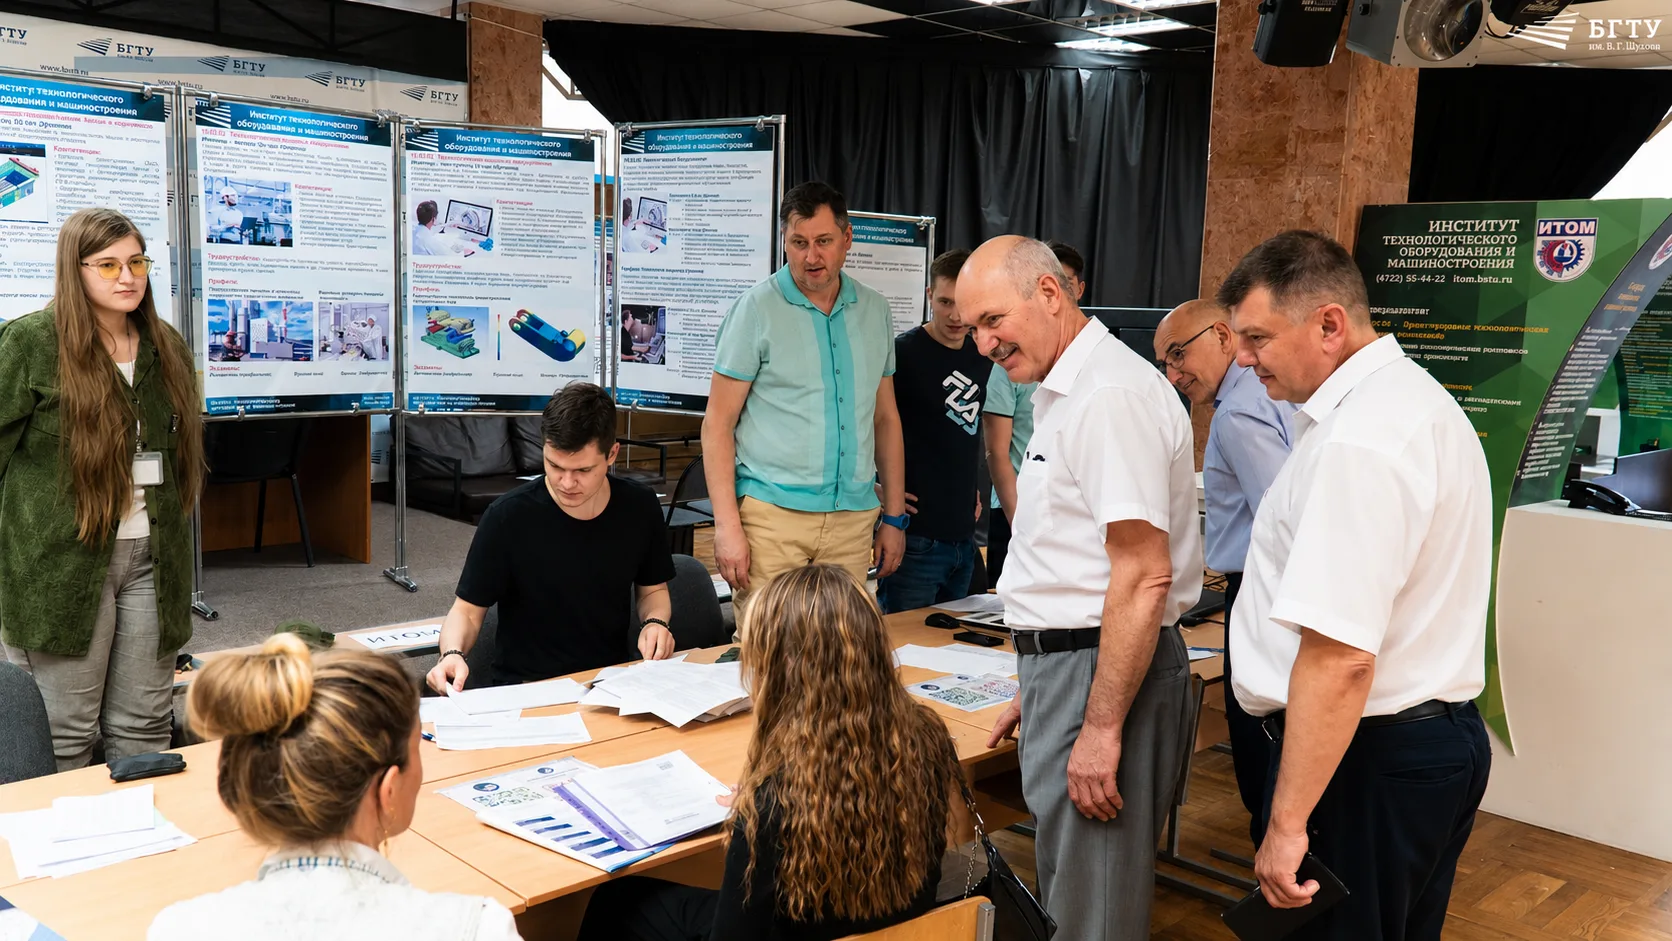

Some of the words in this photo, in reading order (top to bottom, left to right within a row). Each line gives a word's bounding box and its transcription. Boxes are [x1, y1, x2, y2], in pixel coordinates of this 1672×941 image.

[0, 27, 27, 39] ГТУ
[116, 43, 154, 56] БГТУ
[233, 60, 266, 72] БГТУ
[335, 76, 366, 87] БГТУ
[430, 90, 459, 102] БГТУ
[1428, 219, 1520, 232] ИНСТИТУТ
[1539, 221, 1596, 235] ИТОМ
[1382, 234, 1518, 245] ТЕХНОЛОГИЧЕСКОГО
[1399, 246, 1503, 258] ОБОРУДОВАНИЯ
[1505, 246, 1516, 257] И
[1387, 258, 1515, 269] МАШИНОСТРОЕНИЯ
[1375, 274, 1404, 284] (4722)
[1405, 274, 1446, 283] 55-44-22
[1452, 274, 1513, 284] itom.bstu.ru
